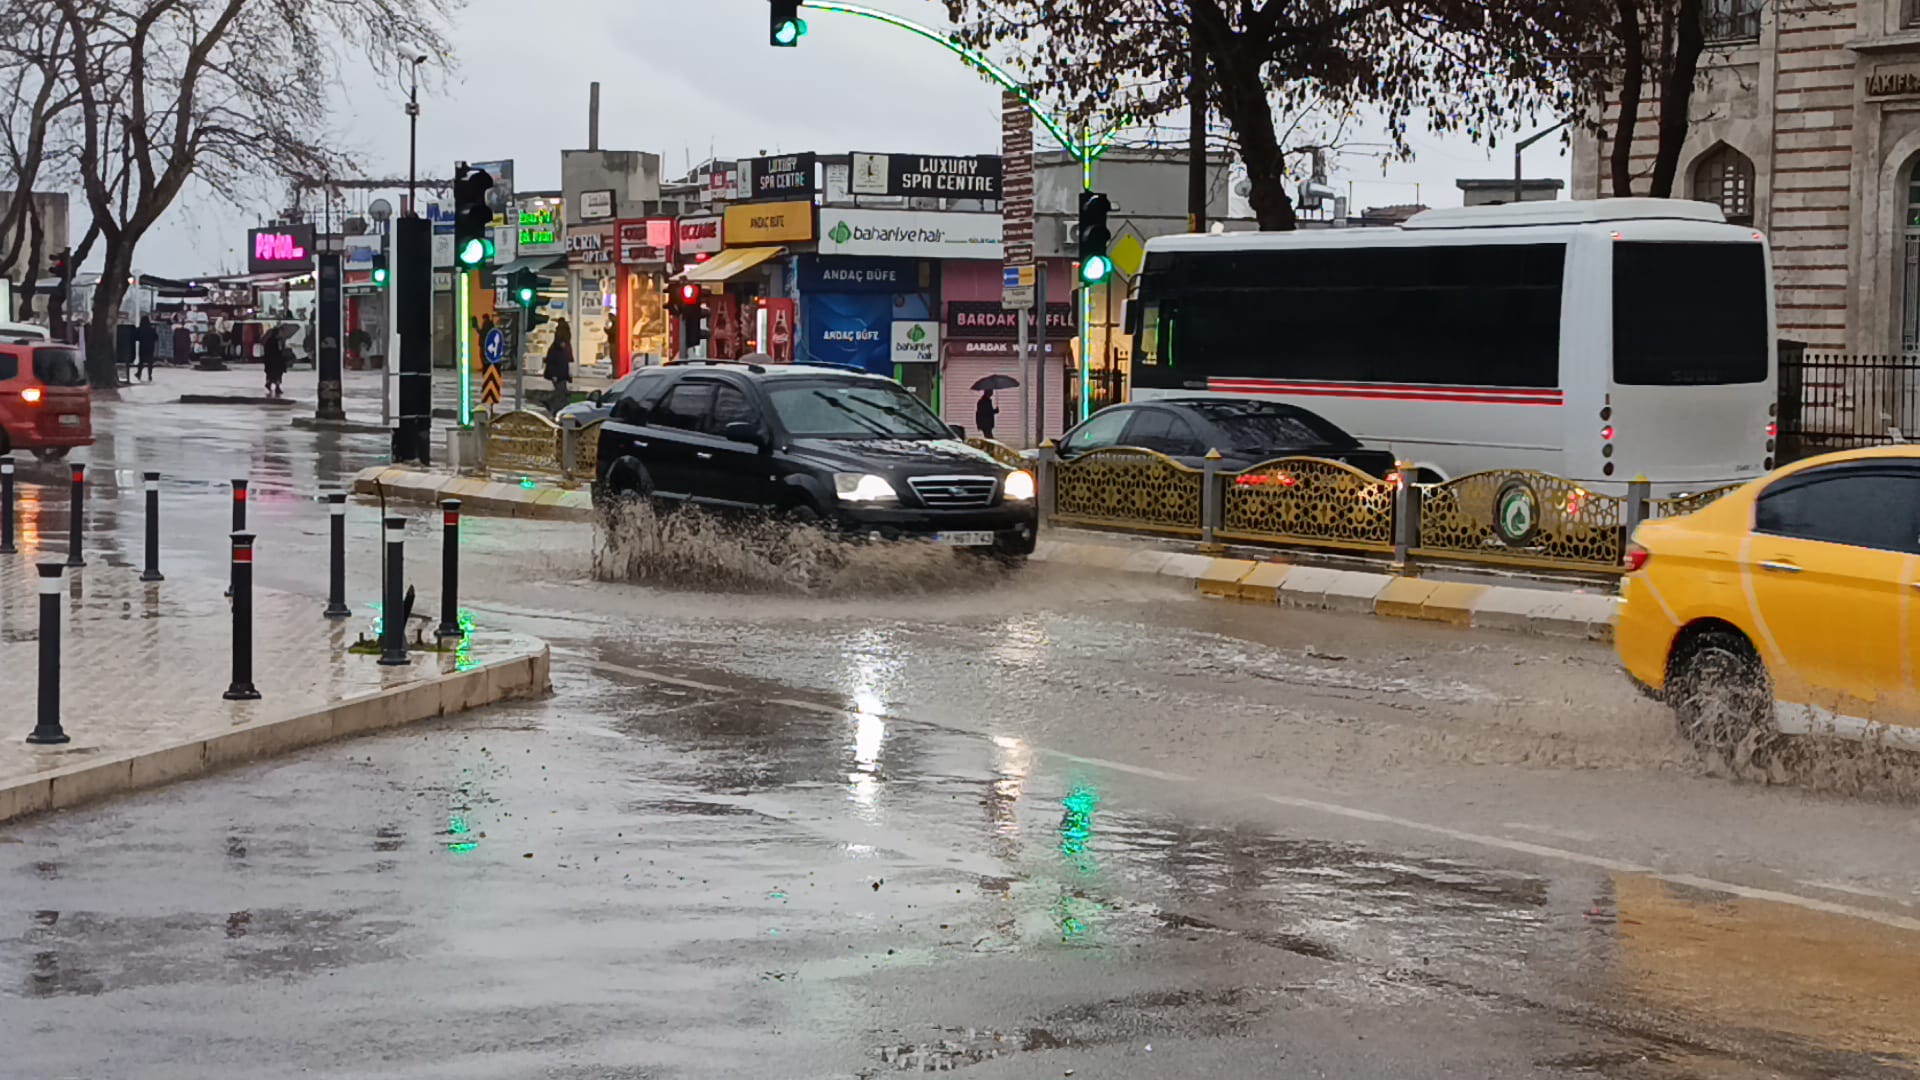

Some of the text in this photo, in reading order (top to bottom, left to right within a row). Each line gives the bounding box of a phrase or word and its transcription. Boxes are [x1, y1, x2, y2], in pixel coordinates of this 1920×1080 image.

[919, 157, 979, 174] LUXURY
[760, 175, 775, 190] SPA
[902, 173, 932, 189] SPA
[937, 175, 995, 192] CENTRE
[853, 225, 944, 243] bahariye hair
[823, 269, 897, 283] ANDAÇ BÜFE
[957, 312, 1016, 327] BARDAK
[823, 330, 854, 342] ANDAÇ
